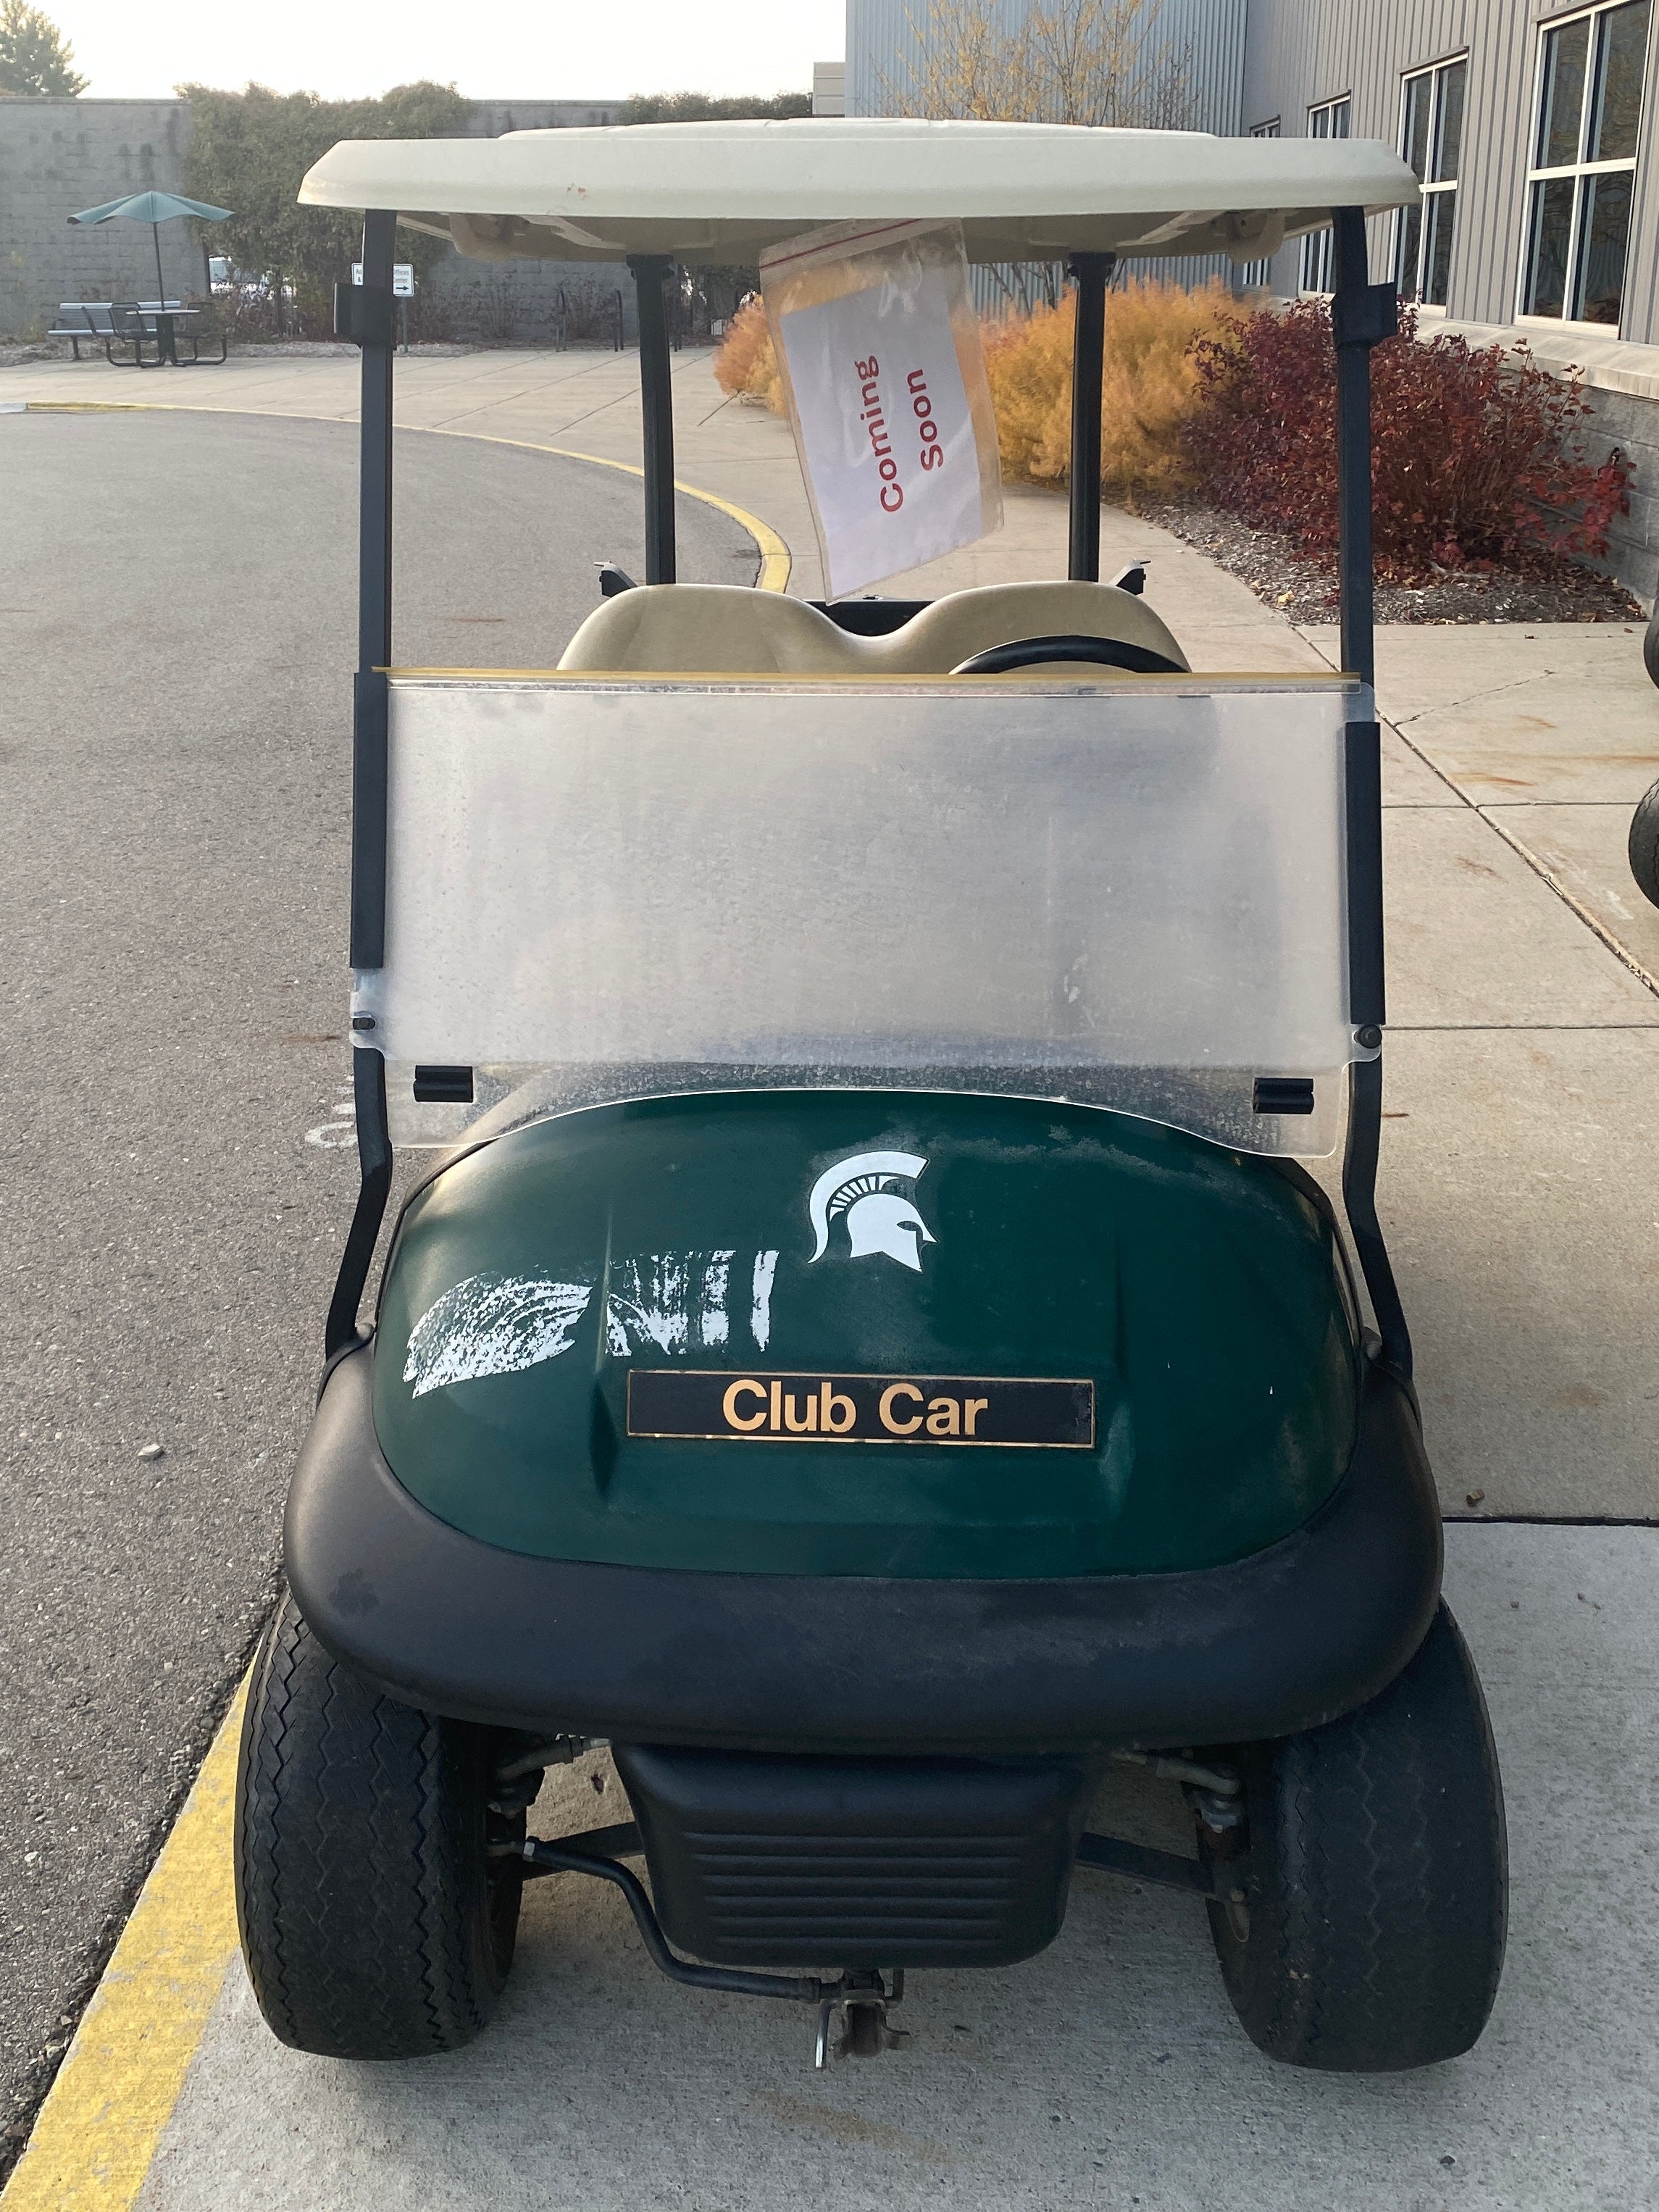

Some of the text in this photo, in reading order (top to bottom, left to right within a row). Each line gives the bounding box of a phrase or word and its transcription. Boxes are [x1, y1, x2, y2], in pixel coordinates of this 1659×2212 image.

[853, 354, 903, 513] Coming
[906, 369, 944, 472] Soon
[722, 1379, 989, 1435] Club Car
